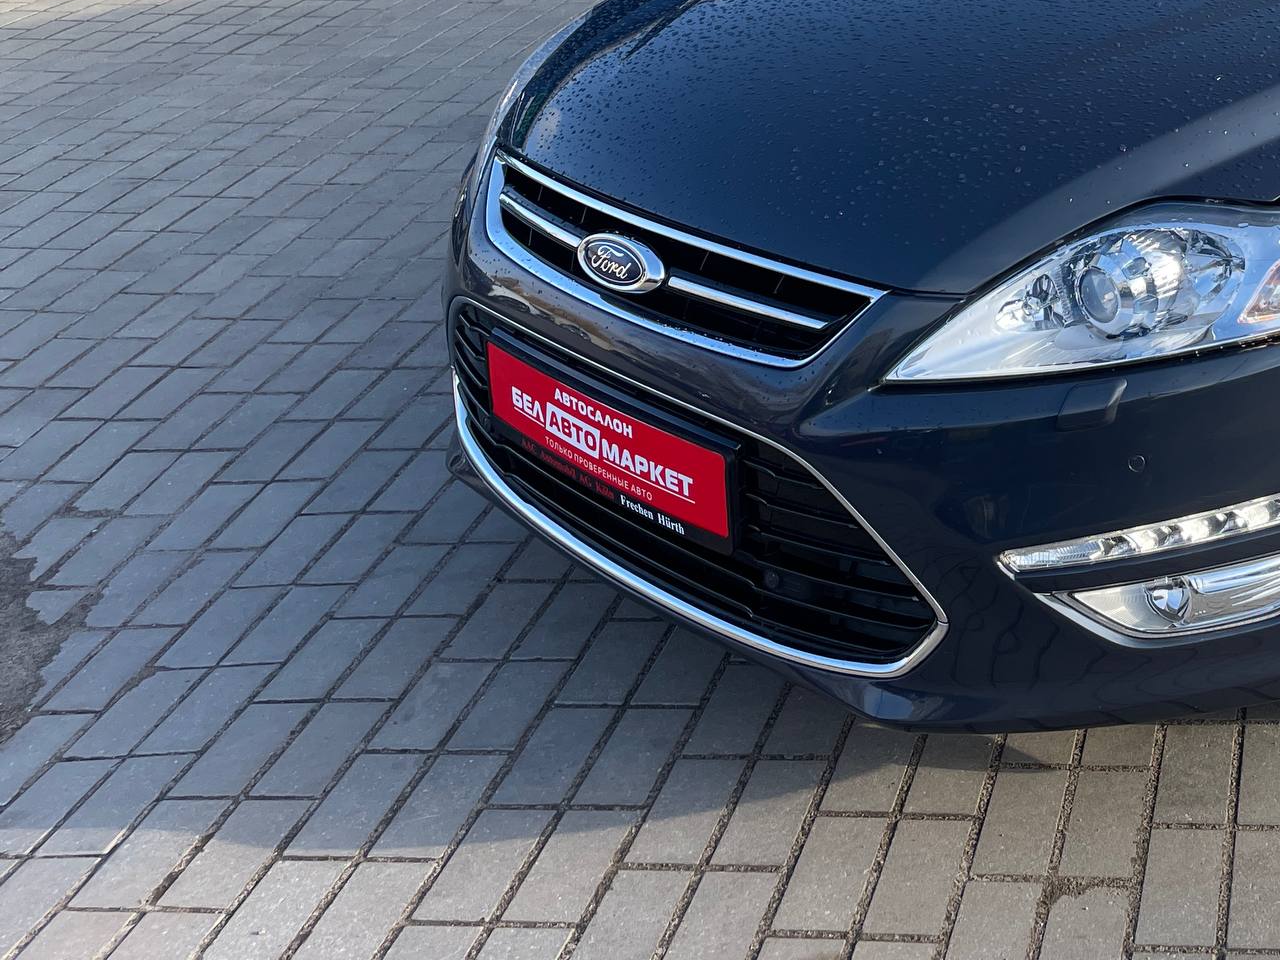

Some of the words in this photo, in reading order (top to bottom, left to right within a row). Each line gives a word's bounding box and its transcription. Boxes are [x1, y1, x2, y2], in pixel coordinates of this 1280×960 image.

[591, 245, 633, 280] Ford
[554, 388, 633, 439] АВТОСАЛОН
[511, 386, 545, 423] БЕЛ
[549, 409, 597, 450] АВТО
[602, 438, 693, 497] МАРКЕТ
[545, 435, 573, 459] ТОЛЬКО
[574, 454, 630, 490] ПРОВЕРЕННЫЕ
[630, 484, 653, 501] АВТО
[620, 494, 654, 520] Frechen
[658, 513, 685, 536] Hürth
